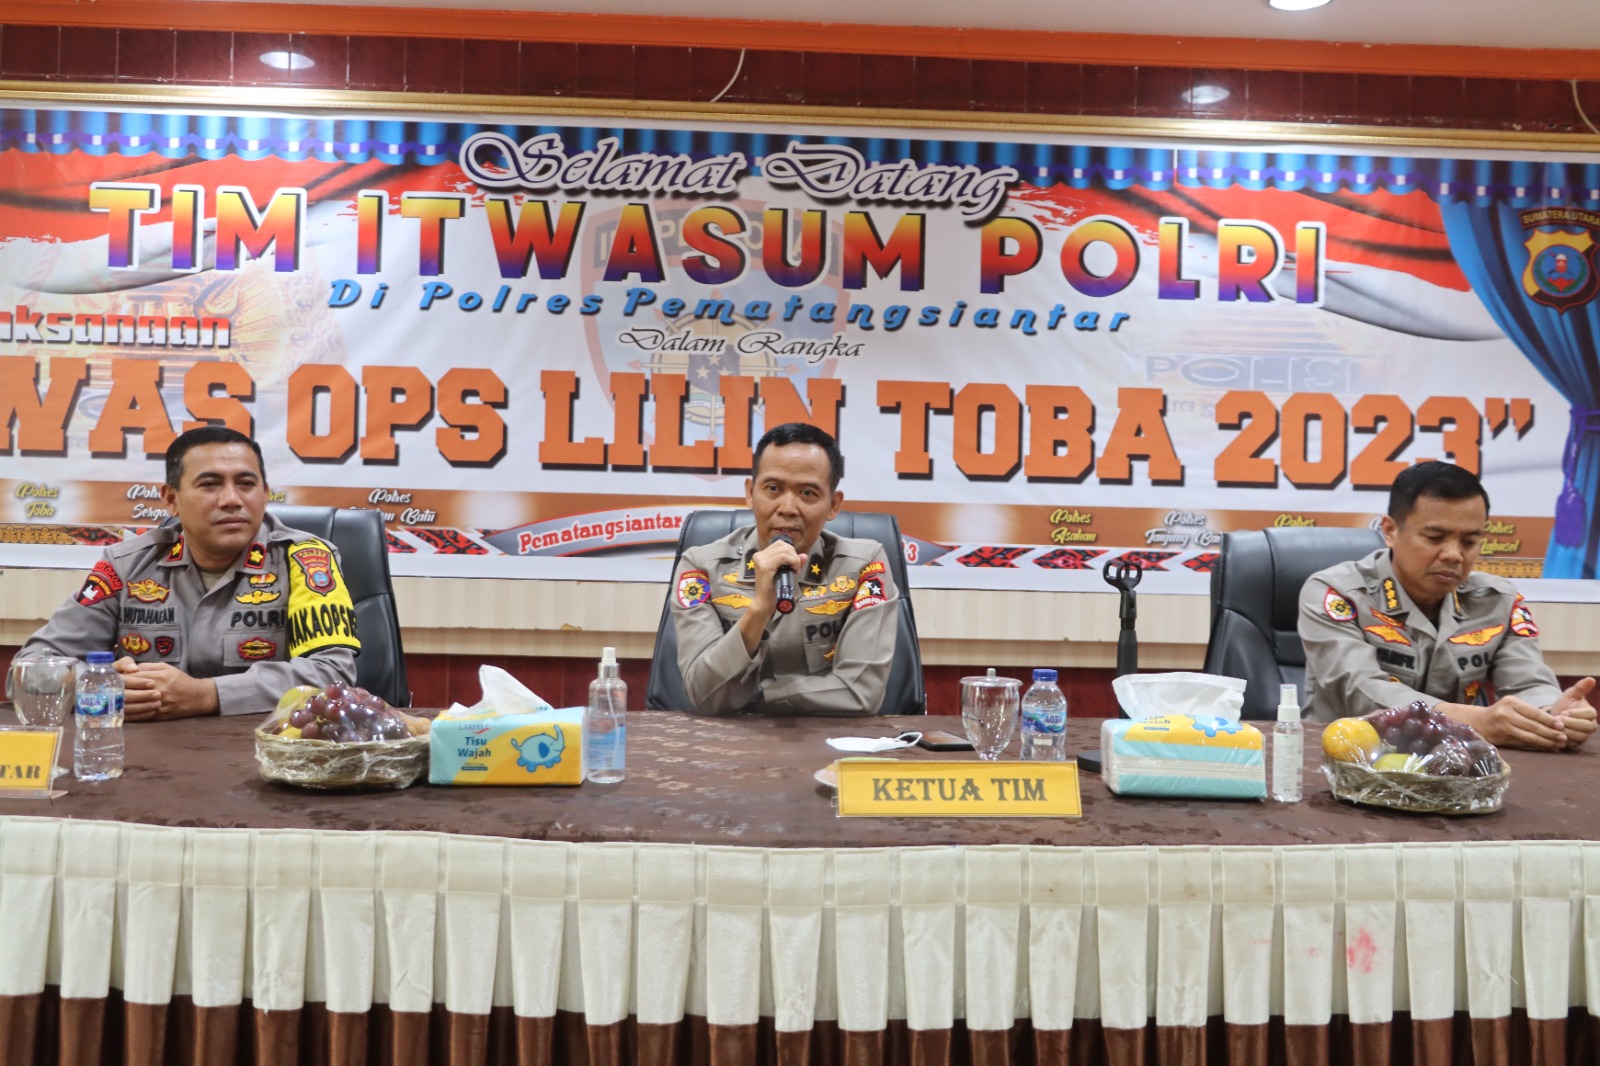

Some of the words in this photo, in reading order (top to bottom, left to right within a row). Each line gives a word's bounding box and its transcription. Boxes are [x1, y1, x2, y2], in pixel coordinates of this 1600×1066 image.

[461, 132, 746, 194] Selamat
[766, 142, 1018, 214] Datang
[1522, 209, 1570, 224] SUMATERA
[90, 188, 304, 273] TIM
[357, 192, 926, 291] ITWASUM
[980, 213, 1326, 305] POLRI
[329, 278, 389, 309] Di
[420, 281, 603, 314] Polres
[623, 286, 1130, 335] Pematangsiantar
[618, 327, 725, 353] Dalam
[738, 331, 865, 363] Rangka
[286, 364, 509, 467] OPS
[538, 369, 846, 476] LILIN
[876, 380, 1184, 485] TOBA
[16, 484, 59, 498] Polres
[368, 488, 412, 504] Polres
[25, 502, 55, 518] Toba
[400, 507, 437, 525] Batu
[1051, 509, 1092, 525] Polres
[1164, 511, 1206, 527] Polres
[519, 513, 684, 554] Pematangsiantar
[1051, 527, 1098, 545] Asahan
[1145, 529, 1191, 547] Tanjung
[230, 609, 287, 628] POLRI
[80, 697, 101, 707] AQUA
[465, 736, 488, 746] Tisu
[457, 748, 492, 759] Wajah
[872, 778, 984, 801] KETUA
[990, 778, 1047, 801] TIM
